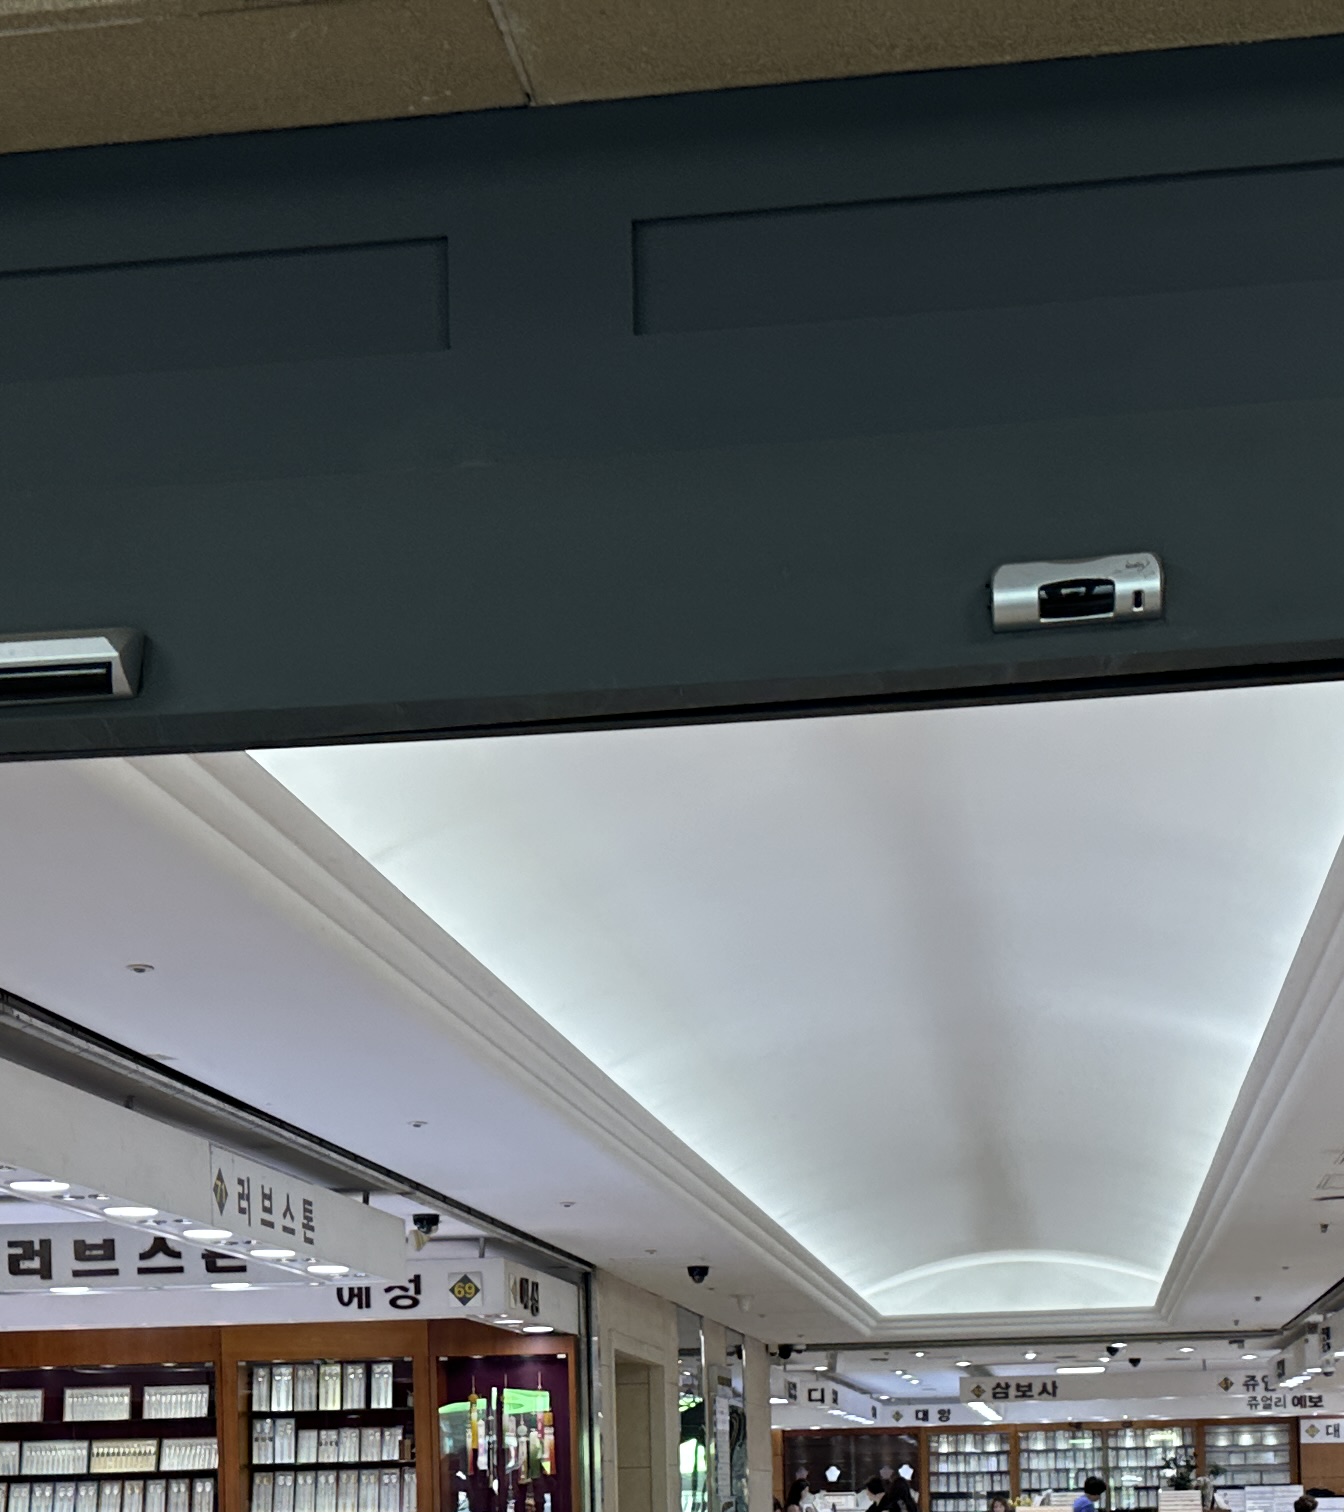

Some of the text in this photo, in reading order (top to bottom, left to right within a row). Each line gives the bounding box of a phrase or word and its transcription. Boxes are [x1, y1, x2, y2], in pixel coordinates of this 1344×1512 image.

[237, 1176, 315, 1246] 러브스톤
[453, 1281, 476, 1298] 69
[992, 1381, 1058, 1400] 삼보사
[1247, 1395, 1324, 1410] 쥬얼리 예보
